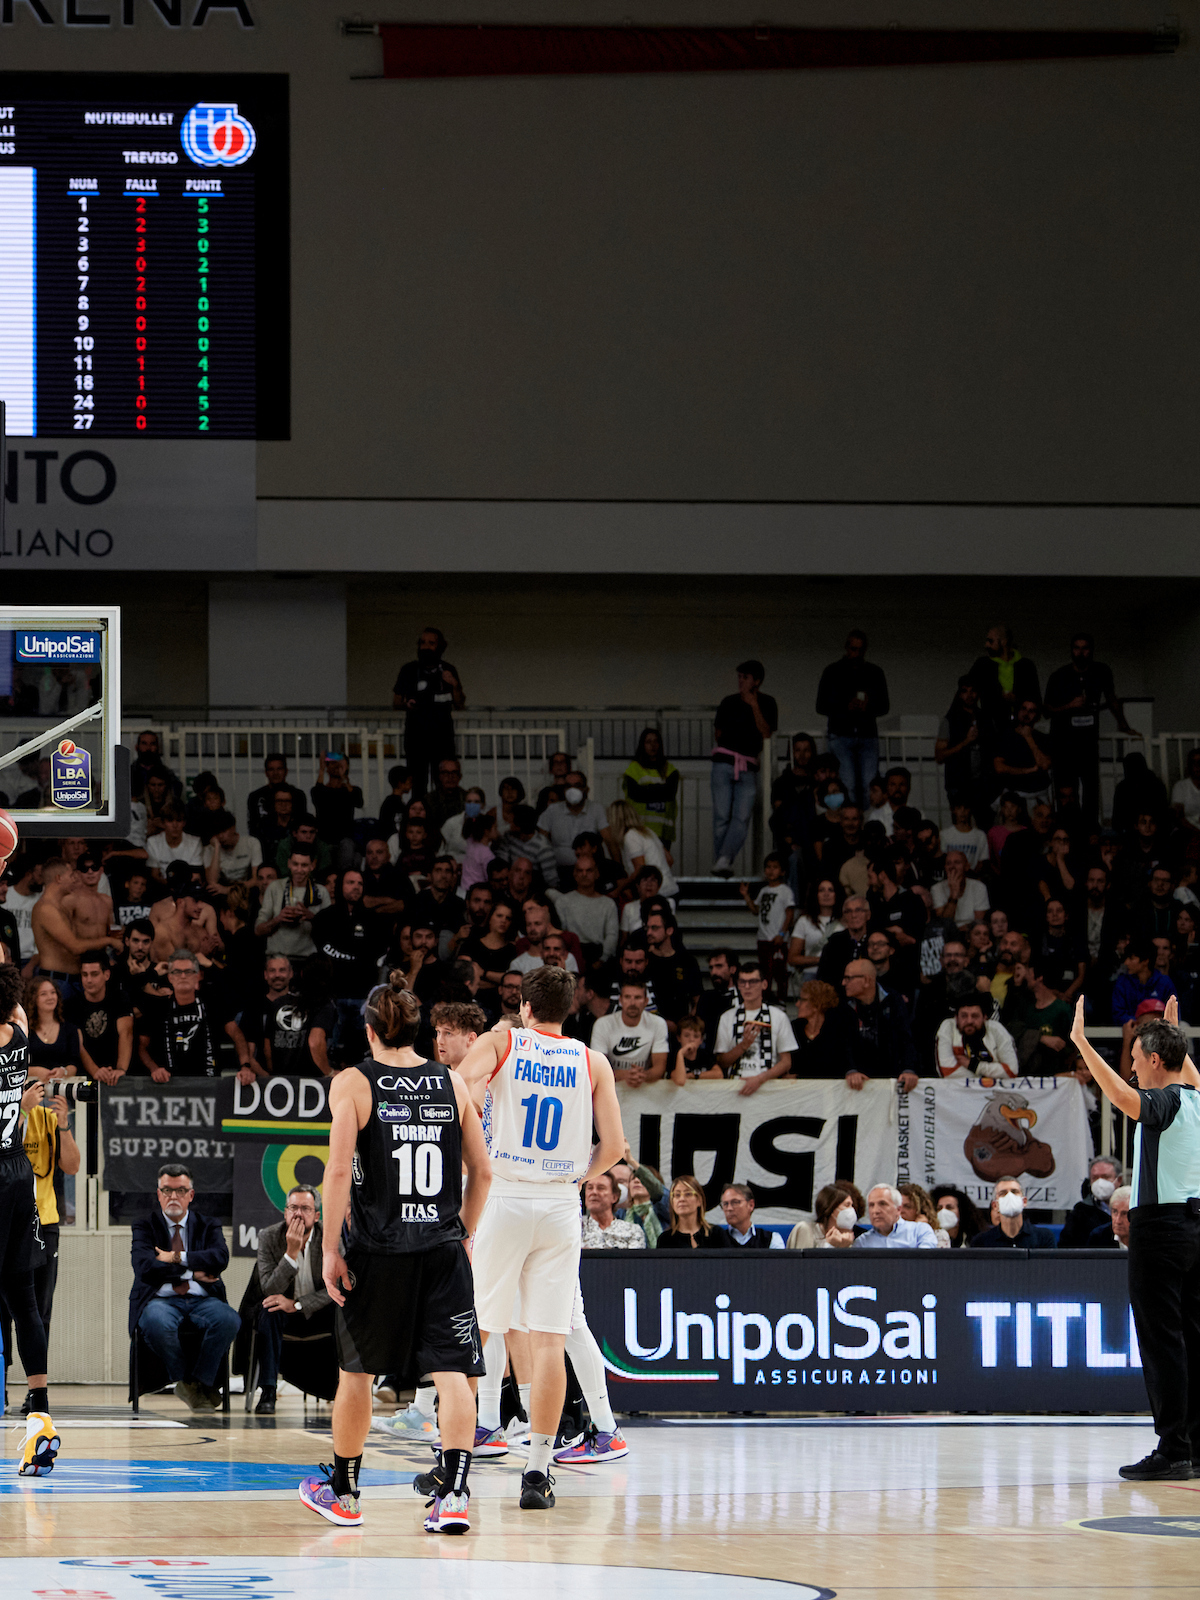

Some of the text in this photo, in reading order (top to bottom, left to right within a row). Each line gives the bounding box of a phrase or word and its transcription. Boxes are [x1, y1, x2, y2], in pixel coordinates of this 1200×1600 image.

[85, 112, 173, 125] NUTRIBULLET
[122, 151, 178, 164] TREVISO
[69, 178, 221, 191] NUM FALLI PUNTI
[78, 197, 208, 213] 1 5
[78, 217, 208, 233] 2 3
[78, 237, 209, 253] 3 0
[78, 256, 209, 273] 6 2
[78, 276, 207, 292] 7 1
[78, 296, 209, 311] 8 0
[78, 315, 209, 332] 9 0
[74, 336, 209, 351] 10 0
[74, 355, 208, 371] 11 4
[74, 375, 209, 391] 18 4
[74, 394, 209, 410] 24 5
[74, 414, 209, 430] 27 2
[24, 635, 95, 658] UnipolSai
[57, 768, 87, 779] LBA
[56, 791, 88, 801] UnipolSai
[618, 1036, 642, 1048] NIKE
[514, 1058, 577, 1088] FAGGIAN
[376, 1075, 444, 1092] CAVIT
[108, 1095, 216, 1127] TREN
[379, 1107, 410, 1117] Melinda
[521, 1093, 564, 1151] 10
[391, 1124, 442, 1142] FORRAY
[924, 1086, 935, 1185] #WEDIEHARD
[500, 1152, 535, 1164] db group
[544, 1161, 572, 1171] CLIPPER
[391, 1143, 443, 1197] 10
[401, 1203, 438, 1218] ITAS
[623, 1286, 938, 1385] UnipolSai
[966, 1301, 1143, 1369] TITL
[754, 1369, 938, 1385] ASSICURAZIONI
